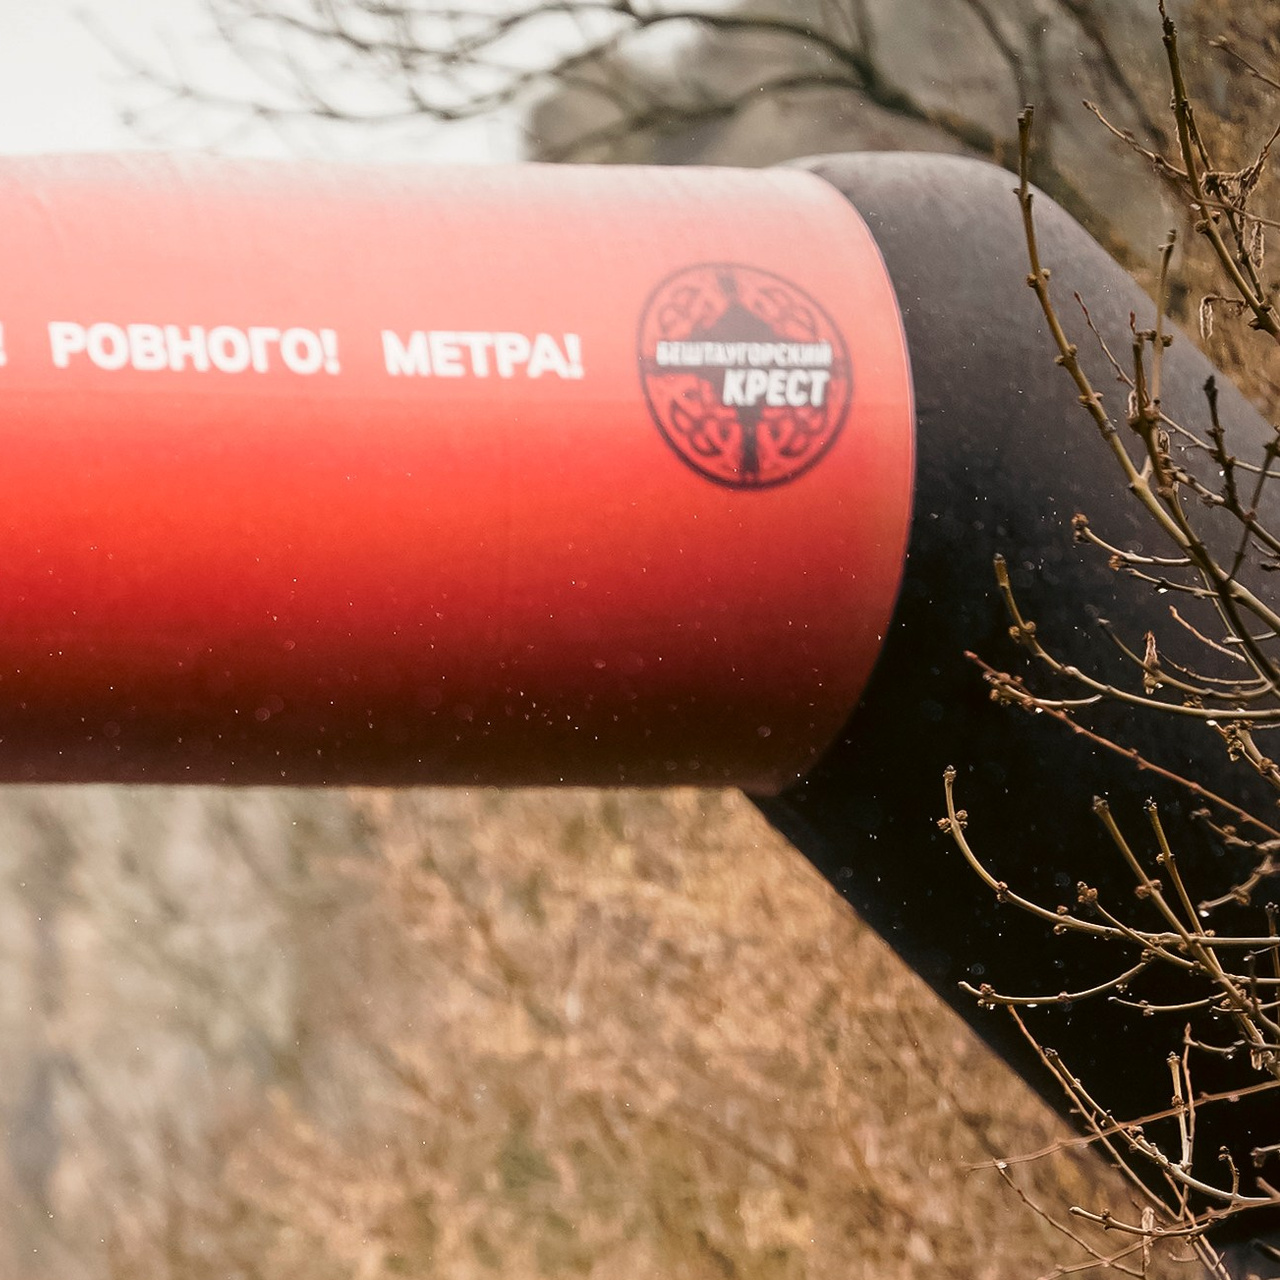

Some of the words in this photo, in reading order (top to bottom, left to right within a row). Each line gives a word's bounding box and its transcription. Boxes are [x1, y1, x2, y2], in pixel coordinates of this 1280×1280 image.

[48, 321, 341, 375] РОВНОГО!
[381, 330, 585, 379] МЕТРА!
[723, 368, 831, 408] КРЕСТ
